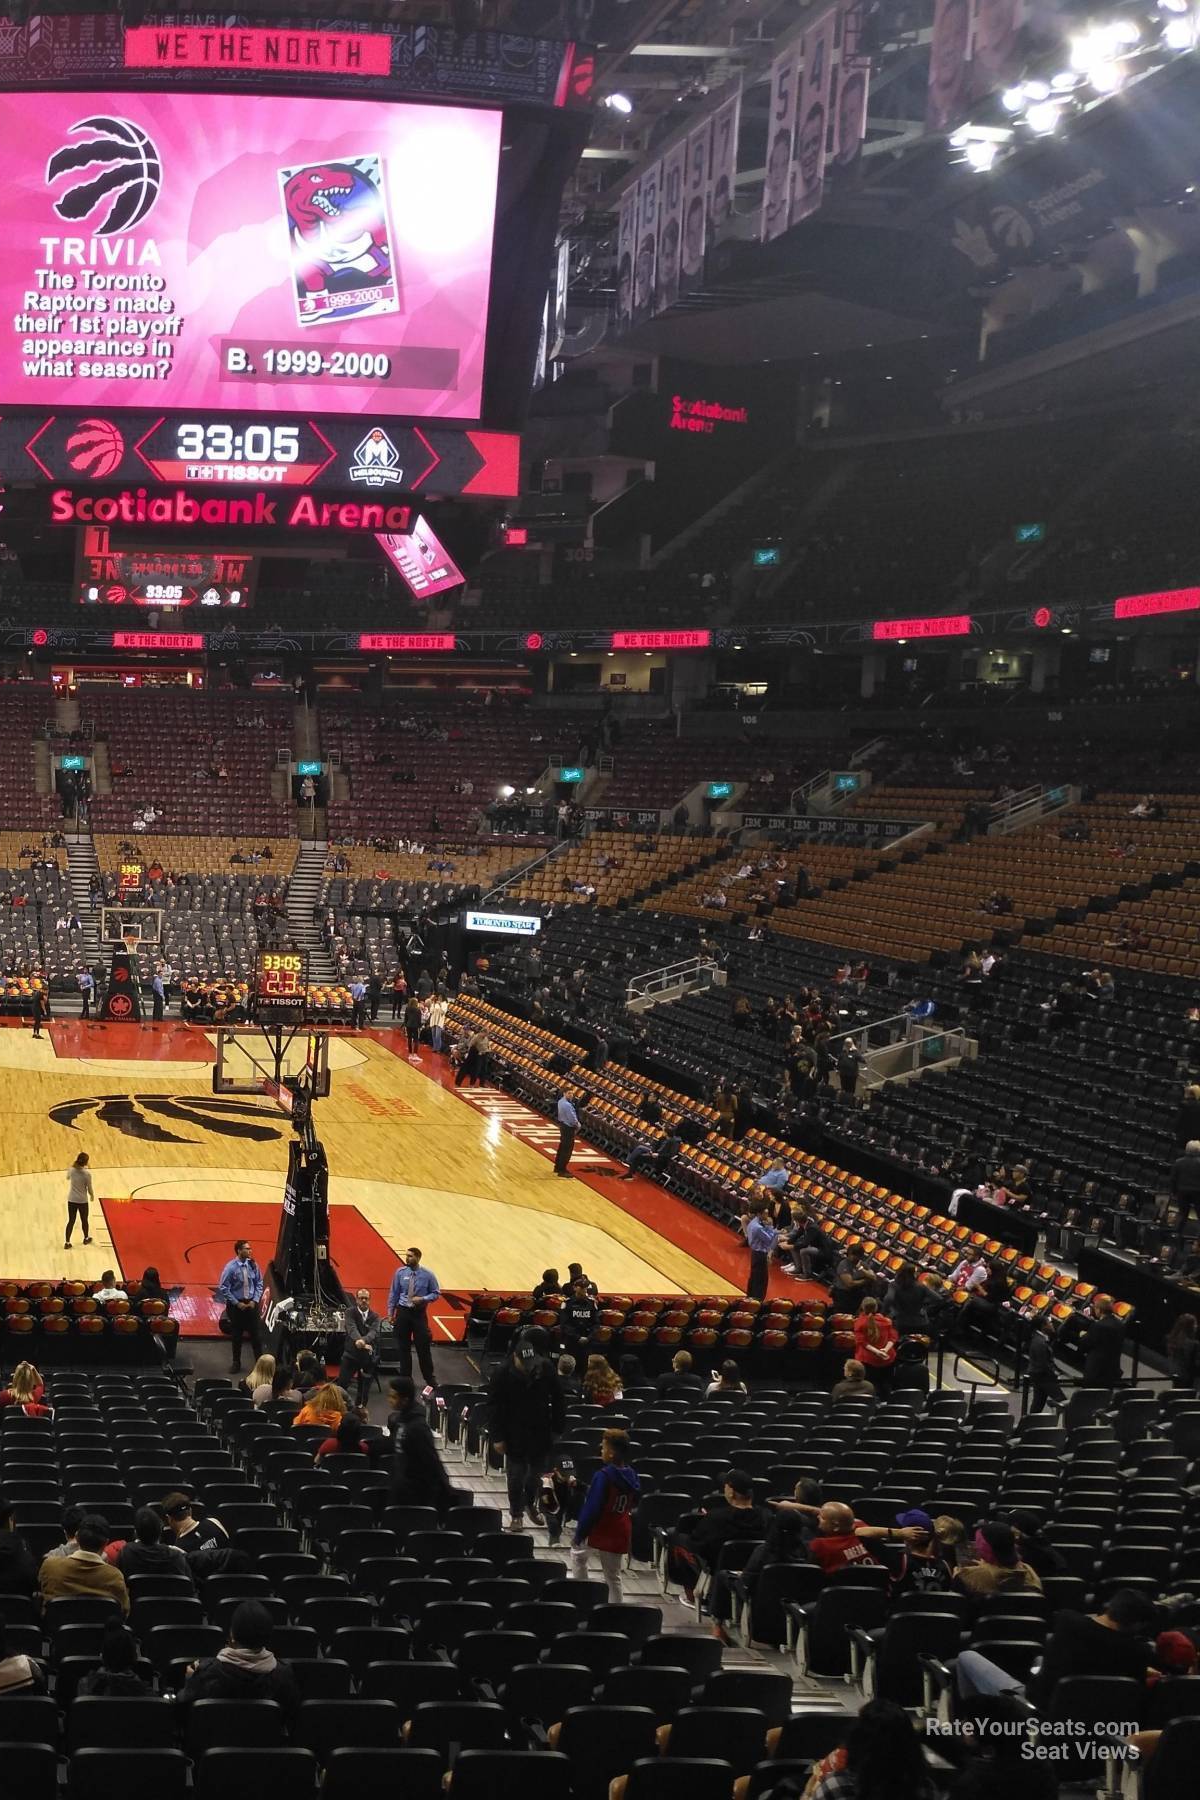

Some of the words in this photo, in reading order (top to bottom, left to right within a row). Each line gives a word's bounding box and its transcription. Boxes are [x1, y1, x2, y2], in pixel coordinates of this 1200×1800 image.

[155, 33, 188, 60] WE
[200, 33, 253, 62] THE
[265, 36, 362, 67] NORTH
[39, 237, 161, 266] TRIVIA
[34, 269, 76, 290] The
[80, 269, 165, 291] Toronto
[23, 290, 109, 315] Raptors
[113, 295, 174, 313] made
[323, 287, 383, 308] 1999-2000
[14, 314, 64, 333] their
[69, 314, 103, 334] 1st
[106, 315, 183, 339] playoff
[22, 338, 147, 359] appearance
[151, 338, 173, 357] in
[22, 358, 75, 377] what
[78, 359, 172, 379] season?
[226, 347, 255, 373] B.
[262, 348, 390, 378] 1999-2000
[672, 395, 748, 424] Scotiabank
[671, 412, 714, 433] Arena
[177, 424, 300, 463] 33:05
[217, 466, 288, 482] TISSOT
[52, 488, 277, 525] Scotiabank
[288, 496, 411, 529] Arena
[145, 585, 183, 599] 33:05
[123, 635, 135, 645] WE
[138, 635, 156, 646] THE
[159, 636, 193, 647] NORTH
[370, 637, 383, 647] WE
[386, 637, 405, 647] THE
[408, 637, 444, 648] NORTH
[623, 635, 637, 646] WE
[640, 634, 661, 645] THE
[663, 634, 699, 645] NORTH
[638, 812, 656, 822] IBM
[744, 817, 761, 827] IBM
[768, 819, 785, 829] IBM
[793, 820, 810, 831] IBM
[818, 821, 836, 833] IBM
[843, 823, 858, 833] IBM
[864, 824, 879, 834] IBM
[885, 824, 900, 835] IBM
[122, 873, 139, 886] 23
[477, 918, 511, 928] TORONTO
[264, 955, 302, 970] 33:05
[266, 970, 296, 994] 23
[271, 998, 304, 1006] TISSOT
[572, 1310, 591, 1319] POLICE
